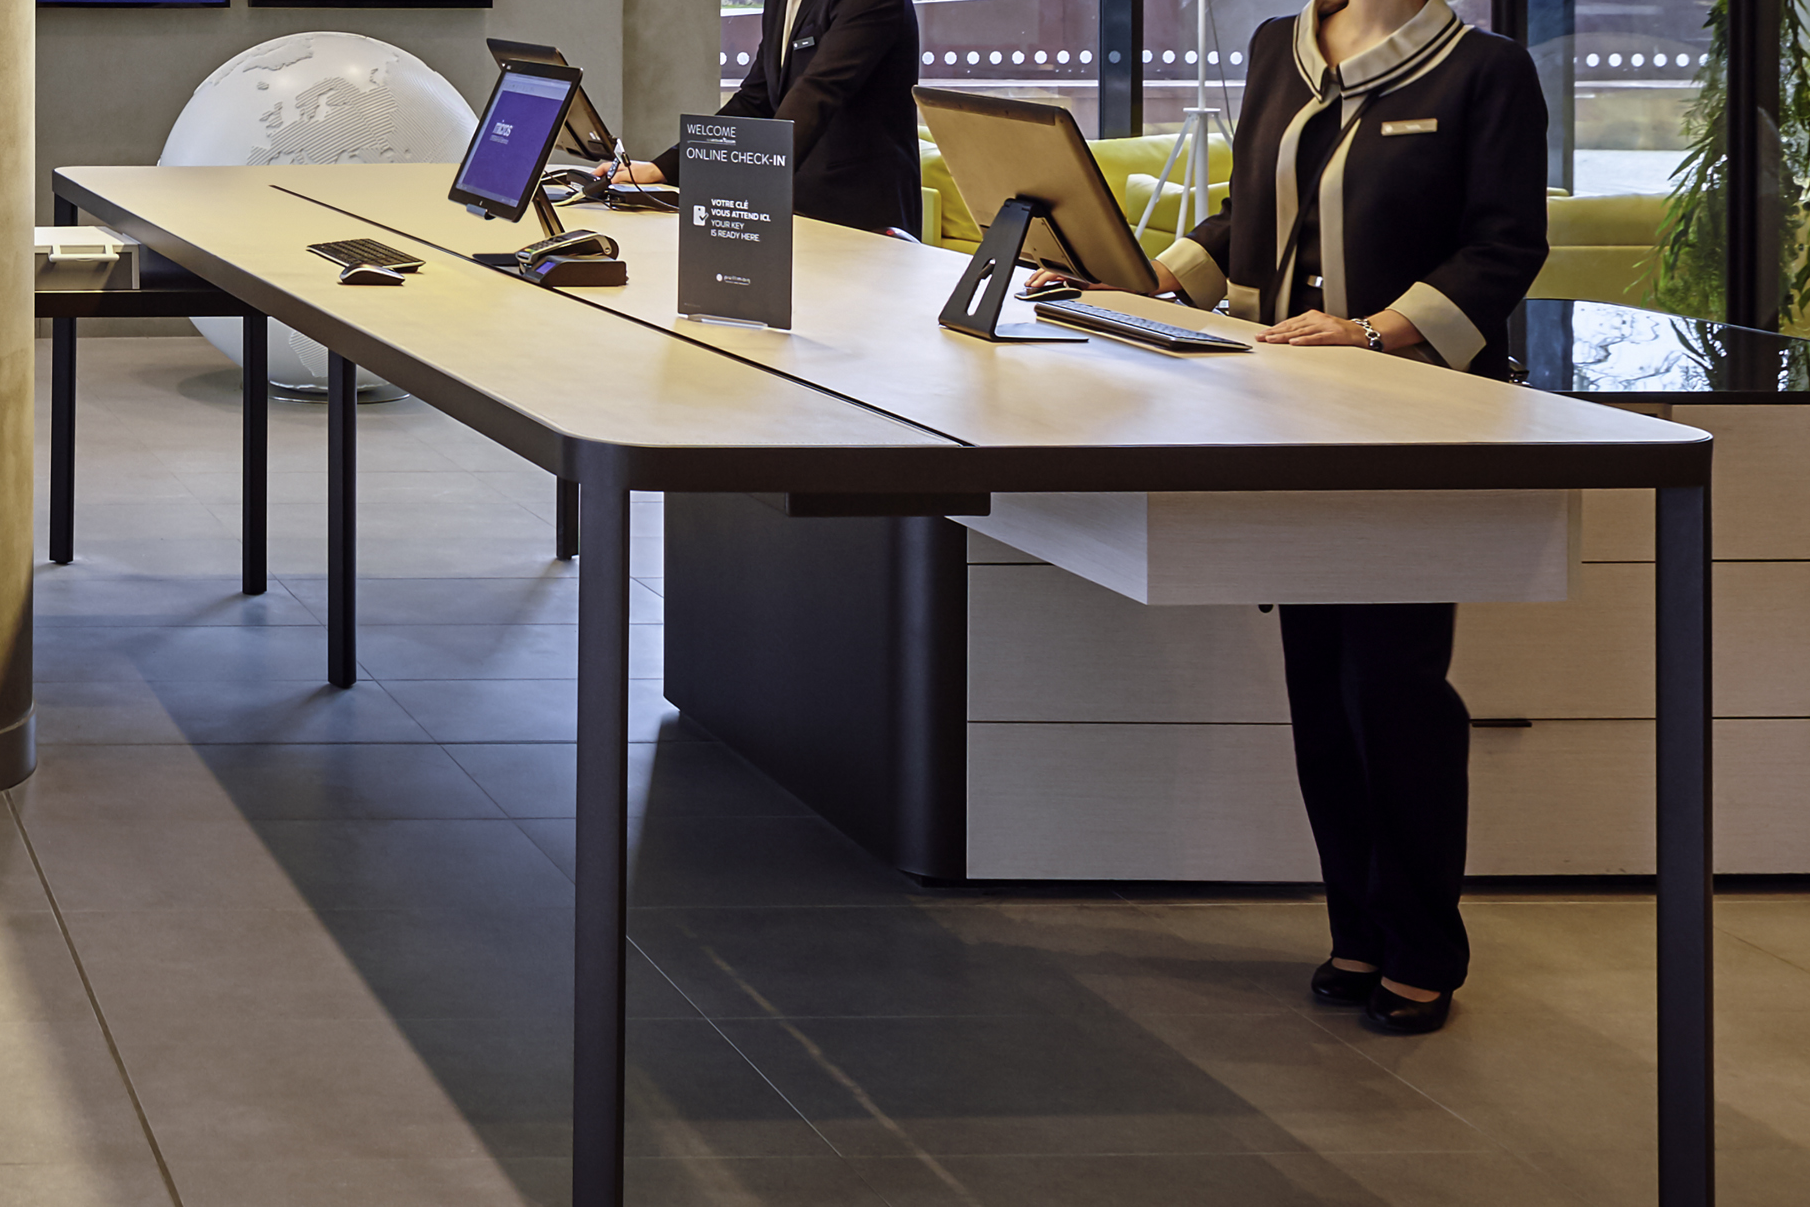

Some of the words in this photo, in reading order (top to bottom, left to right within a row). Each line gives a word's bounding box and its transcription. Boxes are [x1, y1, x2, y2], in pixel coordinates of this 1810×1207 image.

[686, 123, 737, 138] WELCOME
[686, 147, 728, 162] ONLINE
[730, 150, 786, 167] CHECK-IN
[711, 198, 734, 208] VOTRE
[735, 199, 749, 209] CLÉ
[711, 208, 730, 217] VOUS
[731, 210, 759, 220] ATTEND
[711, 219, 730, 228] YOUR
[731, 221, 745, 230] KEY
[710, 228, 717, 237] IS
[718, 229, 740, 239] READY
